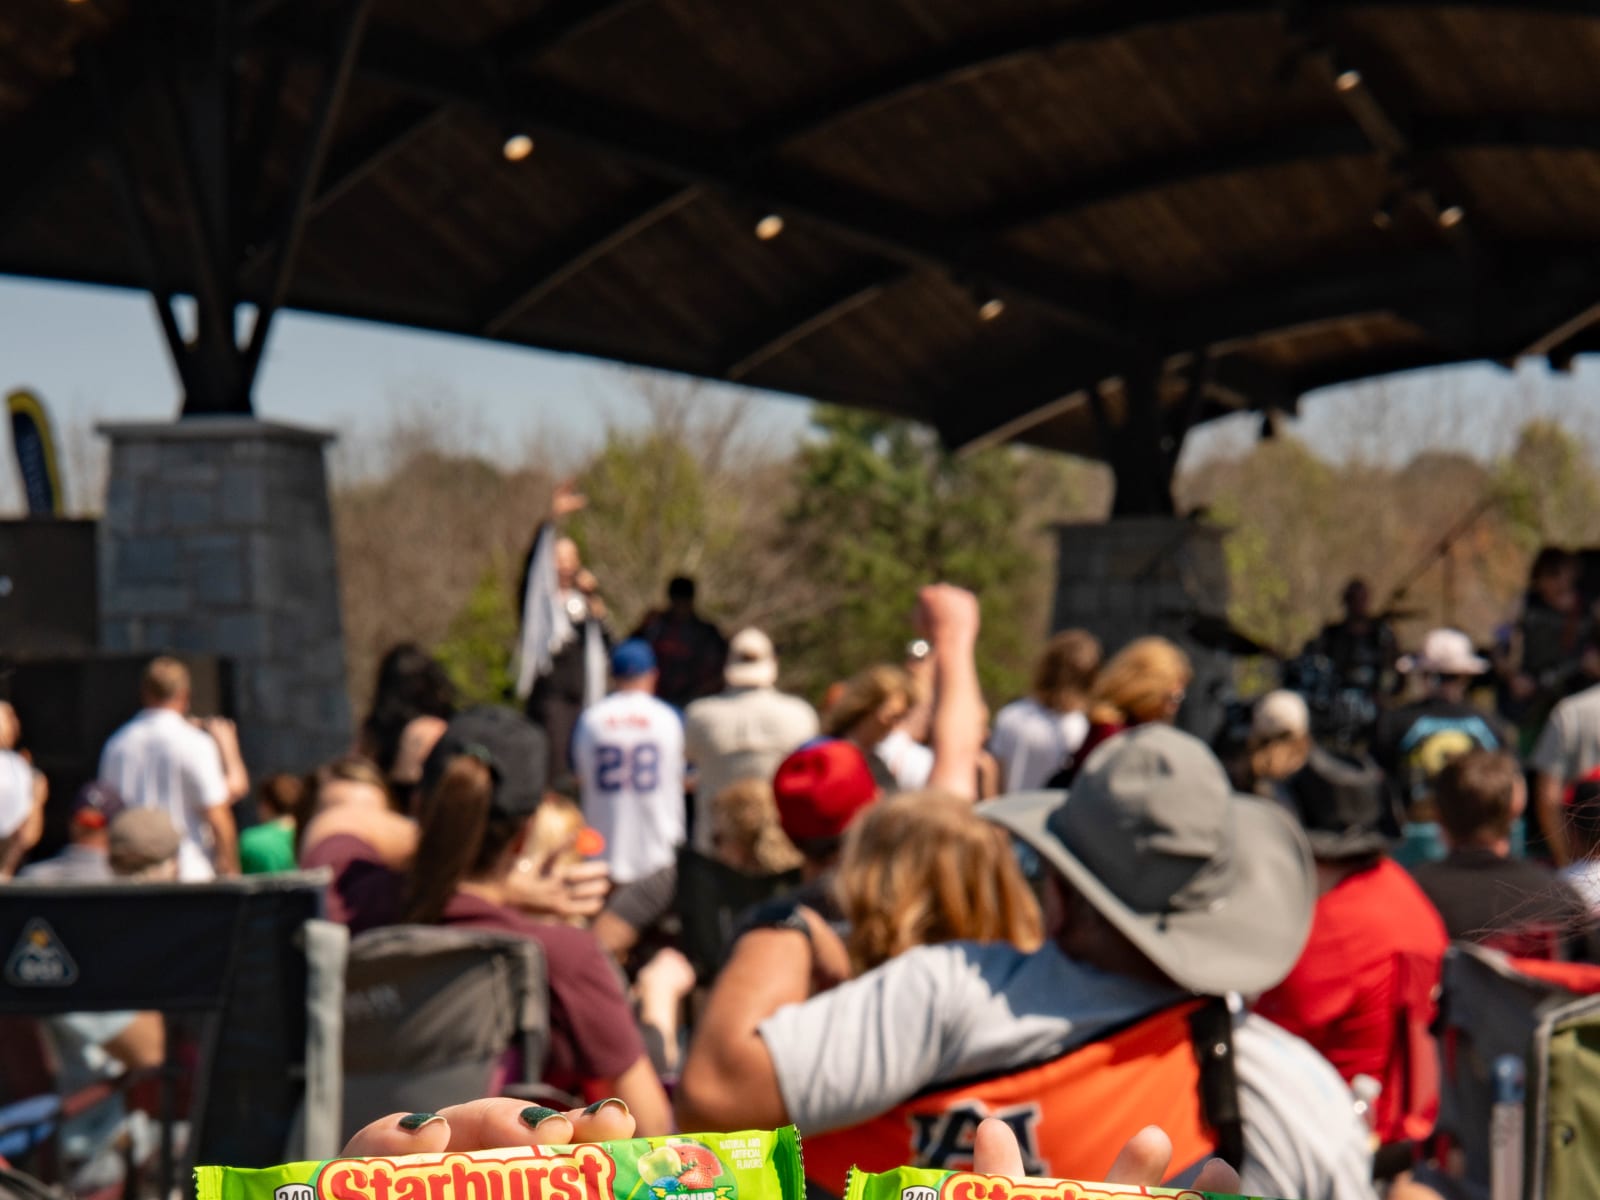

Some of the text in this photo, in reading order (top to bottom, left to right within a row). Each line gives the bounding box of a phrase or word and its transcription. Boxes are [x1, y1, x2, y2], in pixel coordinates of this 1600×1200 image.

[595, 743, 659, 793] 28
[720, 1138, 761, 1149] NATURAL AND
[731, 1148, 761, 1159] ARTIFICIAL
[736, 1159, 763, 1169] FLAVORS
